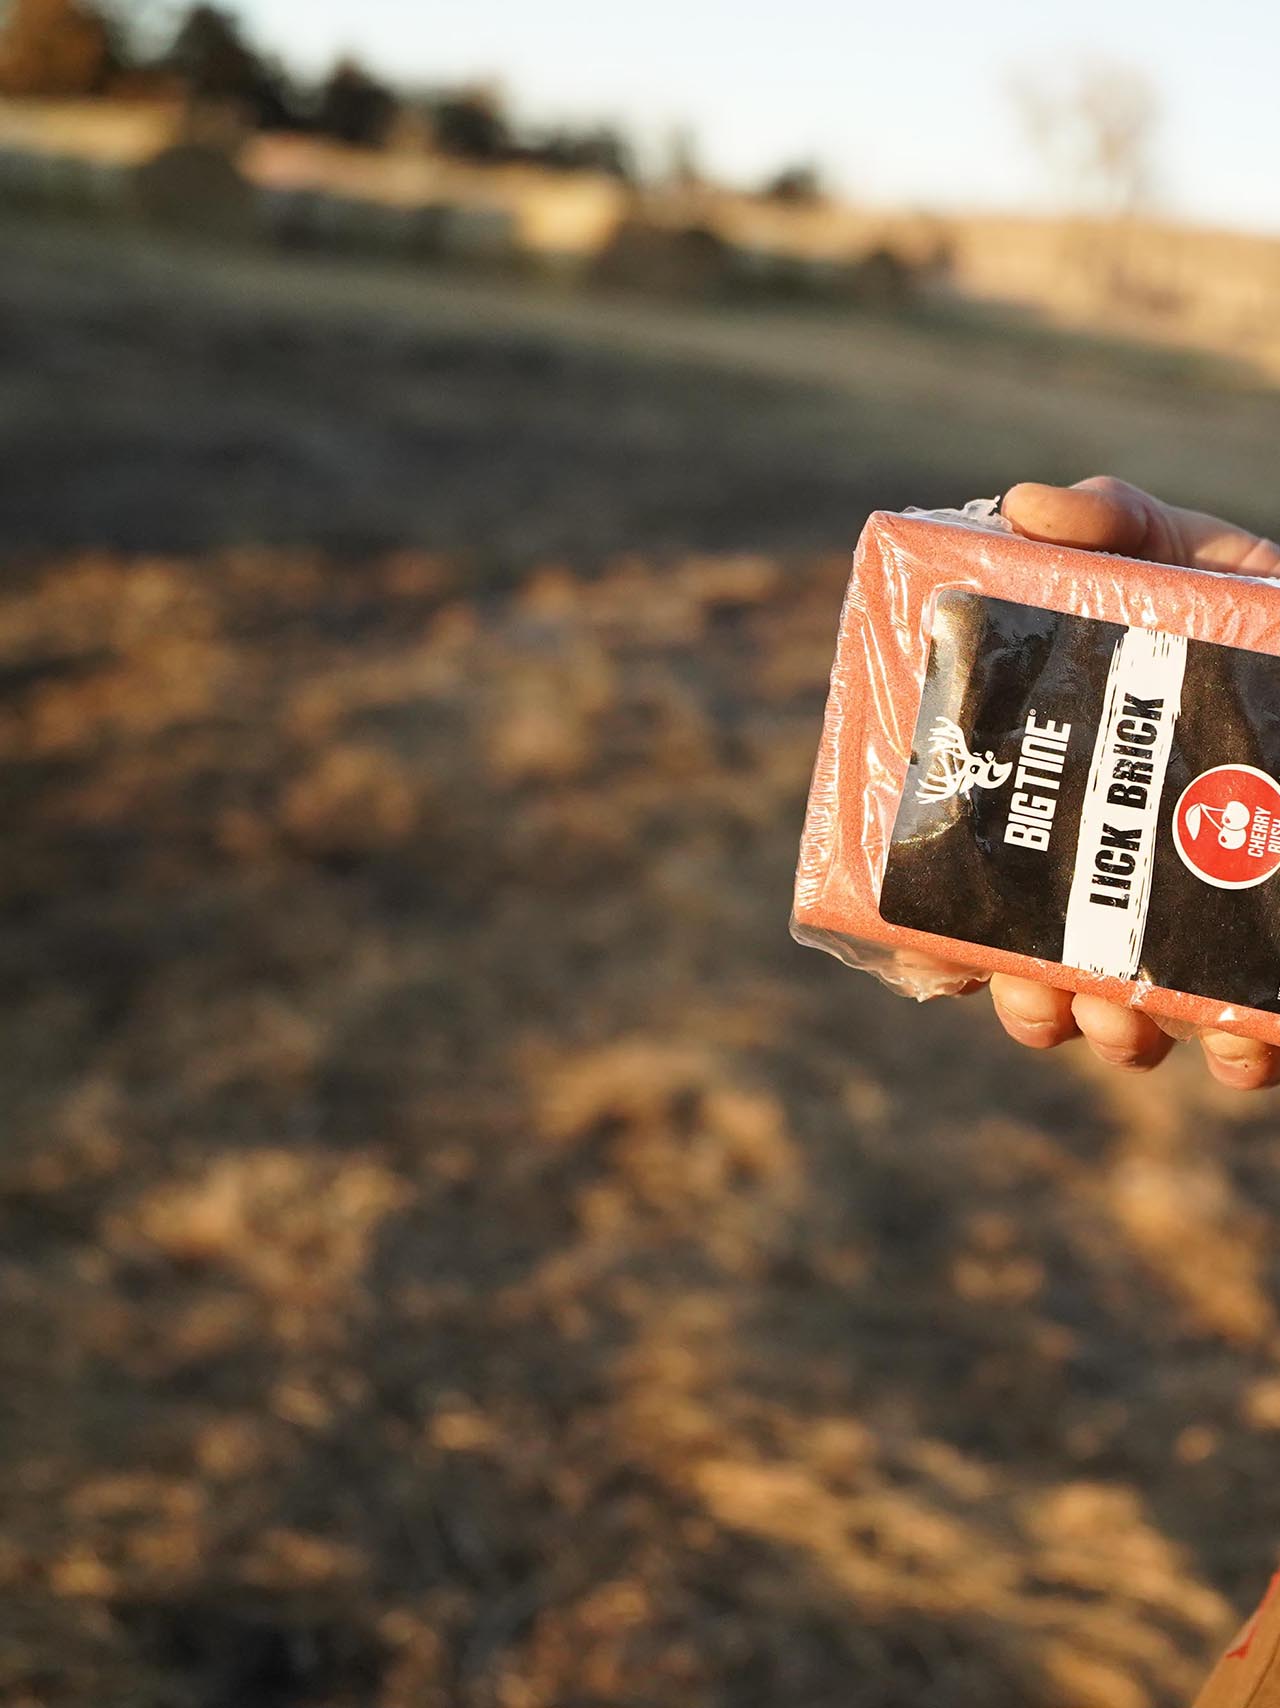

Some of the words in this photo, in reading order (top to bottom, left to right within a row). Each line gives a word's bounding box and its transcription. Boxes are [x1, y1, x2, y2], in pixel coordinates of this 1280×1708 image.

[1107, 694, 1164, 809] BRICK
[1090, 824, 1142, 909] LICK
[1247, 806, 1271, 858] CHERRY
